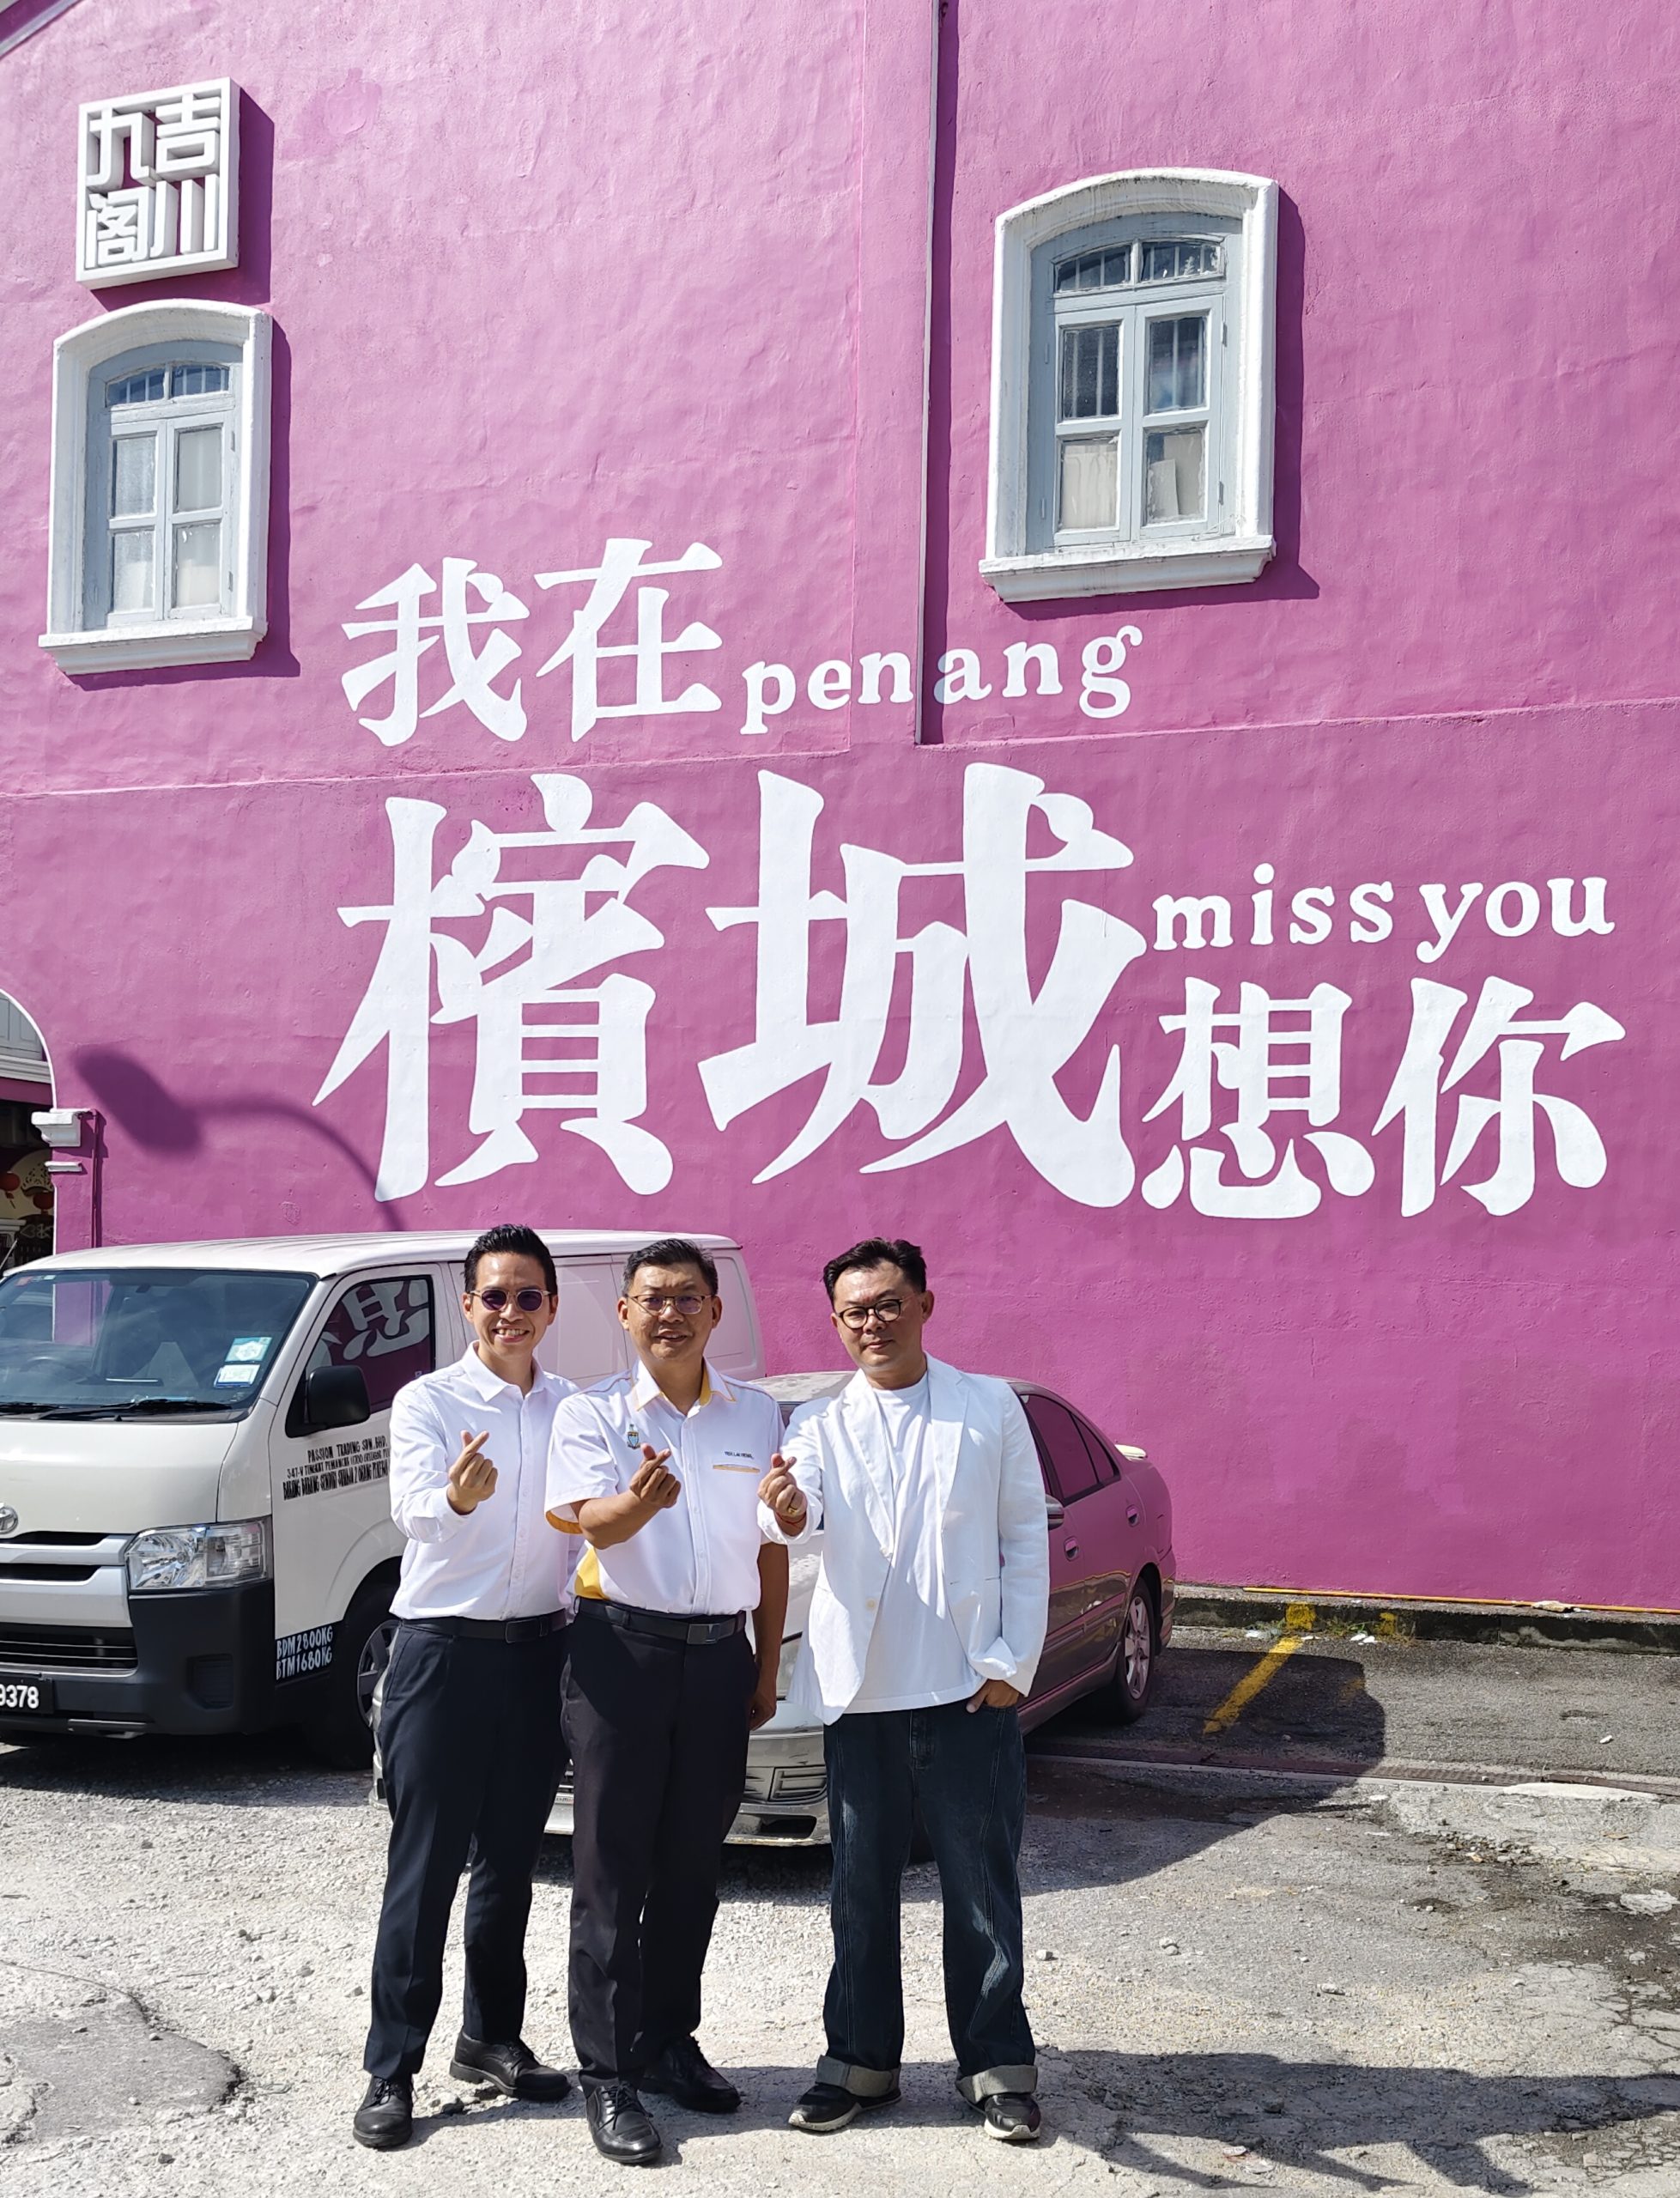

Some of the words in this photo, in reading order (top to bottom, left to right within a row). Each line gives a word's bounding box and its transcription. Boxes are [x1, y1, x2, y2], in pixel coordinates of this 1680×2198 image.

[341, 537, 724, 747] 我在
[740, 625, 1143, 735] penang
[312, 762, 1148, 1208] 檳城
[1152, 862, 1394, 951] miss
[1416, 876, 1616, 963] you
[1142, 975, 1626, 1219] 想你
[307, 1446, 334, 1463] PASSION
[337, 1441, 361, 1458] TRADING
